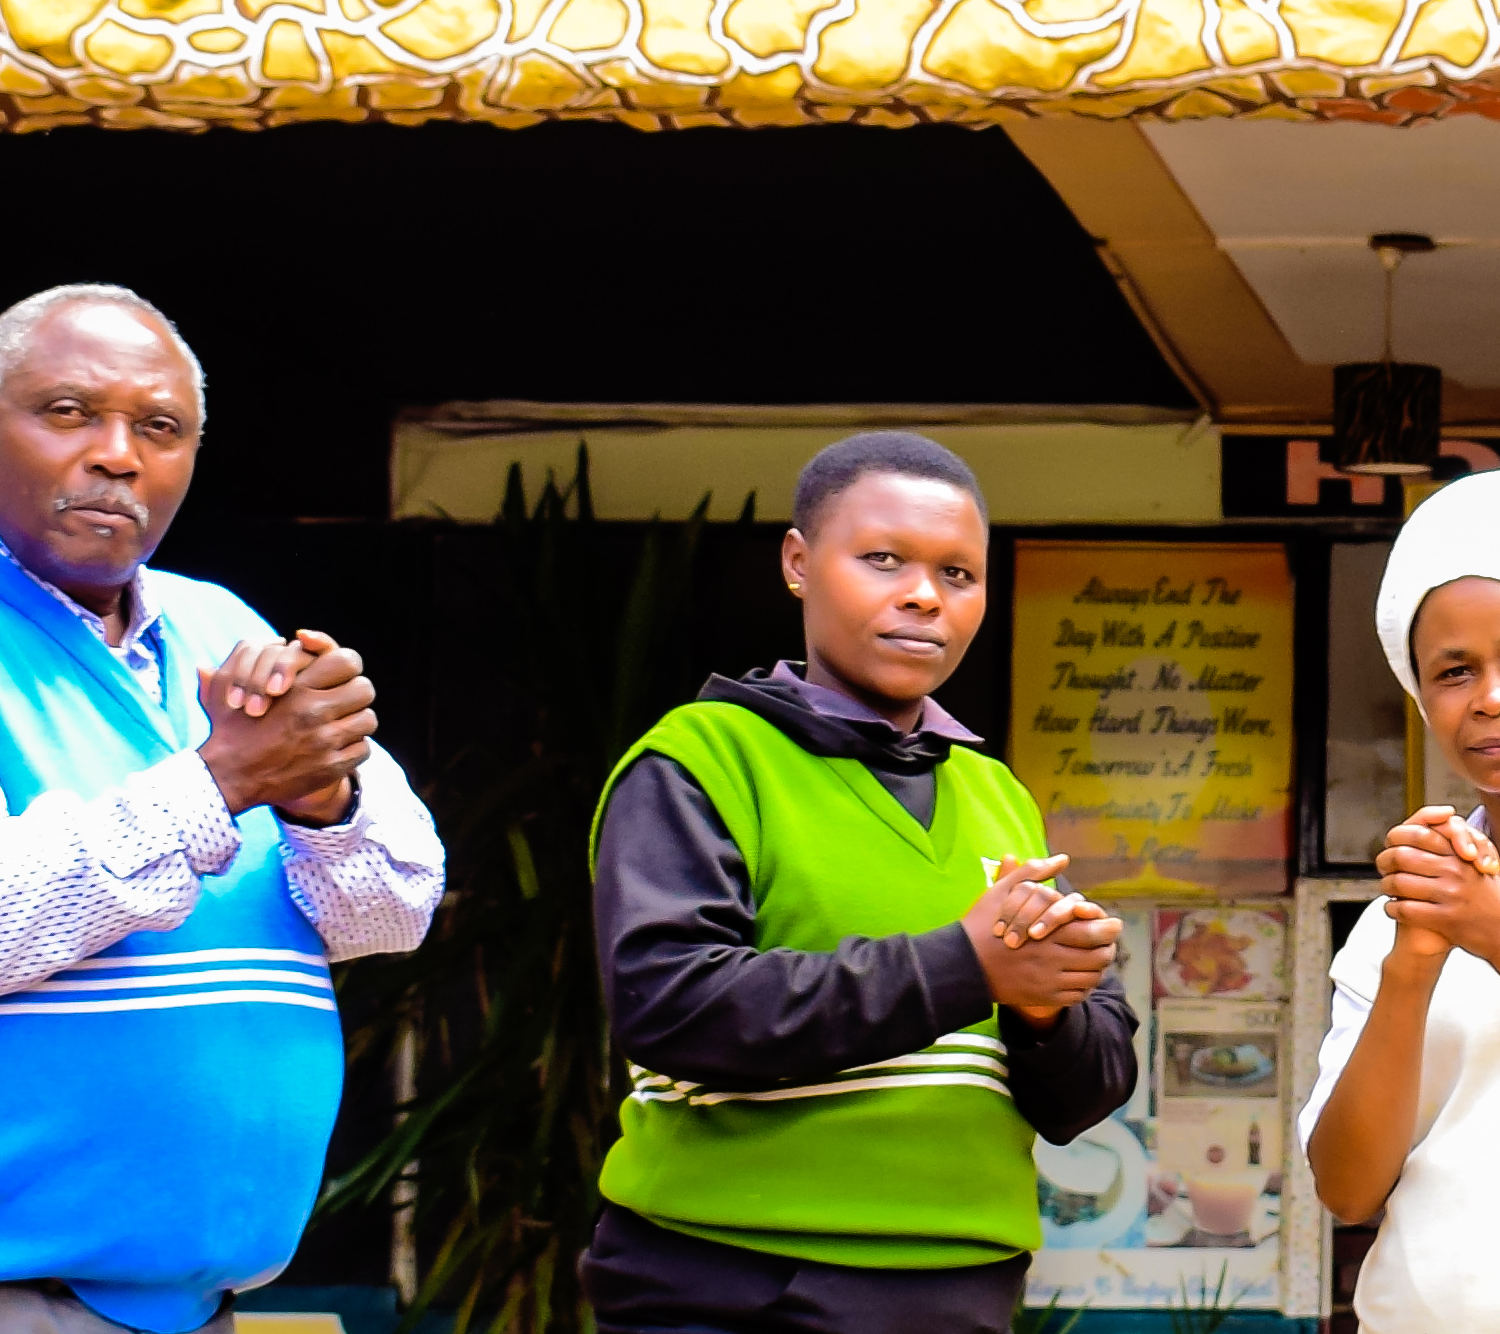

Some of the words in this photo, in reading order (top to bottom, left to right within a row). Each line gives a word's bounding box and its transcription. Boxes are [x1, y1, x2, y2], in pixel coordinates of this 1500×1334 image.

[1073, 575, 1150, 611] Always
[1154, 575, 1195, 605] End
[1201, 575, 1243, 605] The
[1054, 618, 1098, 655] Day
[1101, 619, 1146, 648] With
[1152, 619, 1178, 648] A
[1181, 619, 1262, 649] Positive
[1151, 661, 1181, 691] No
[1188, 665, 1265, 692] Matter
[1032, 704, 1080, 734] How
[1090, 708, 1145, 734] Hard
[1150, 704, 1218, 743] Things
